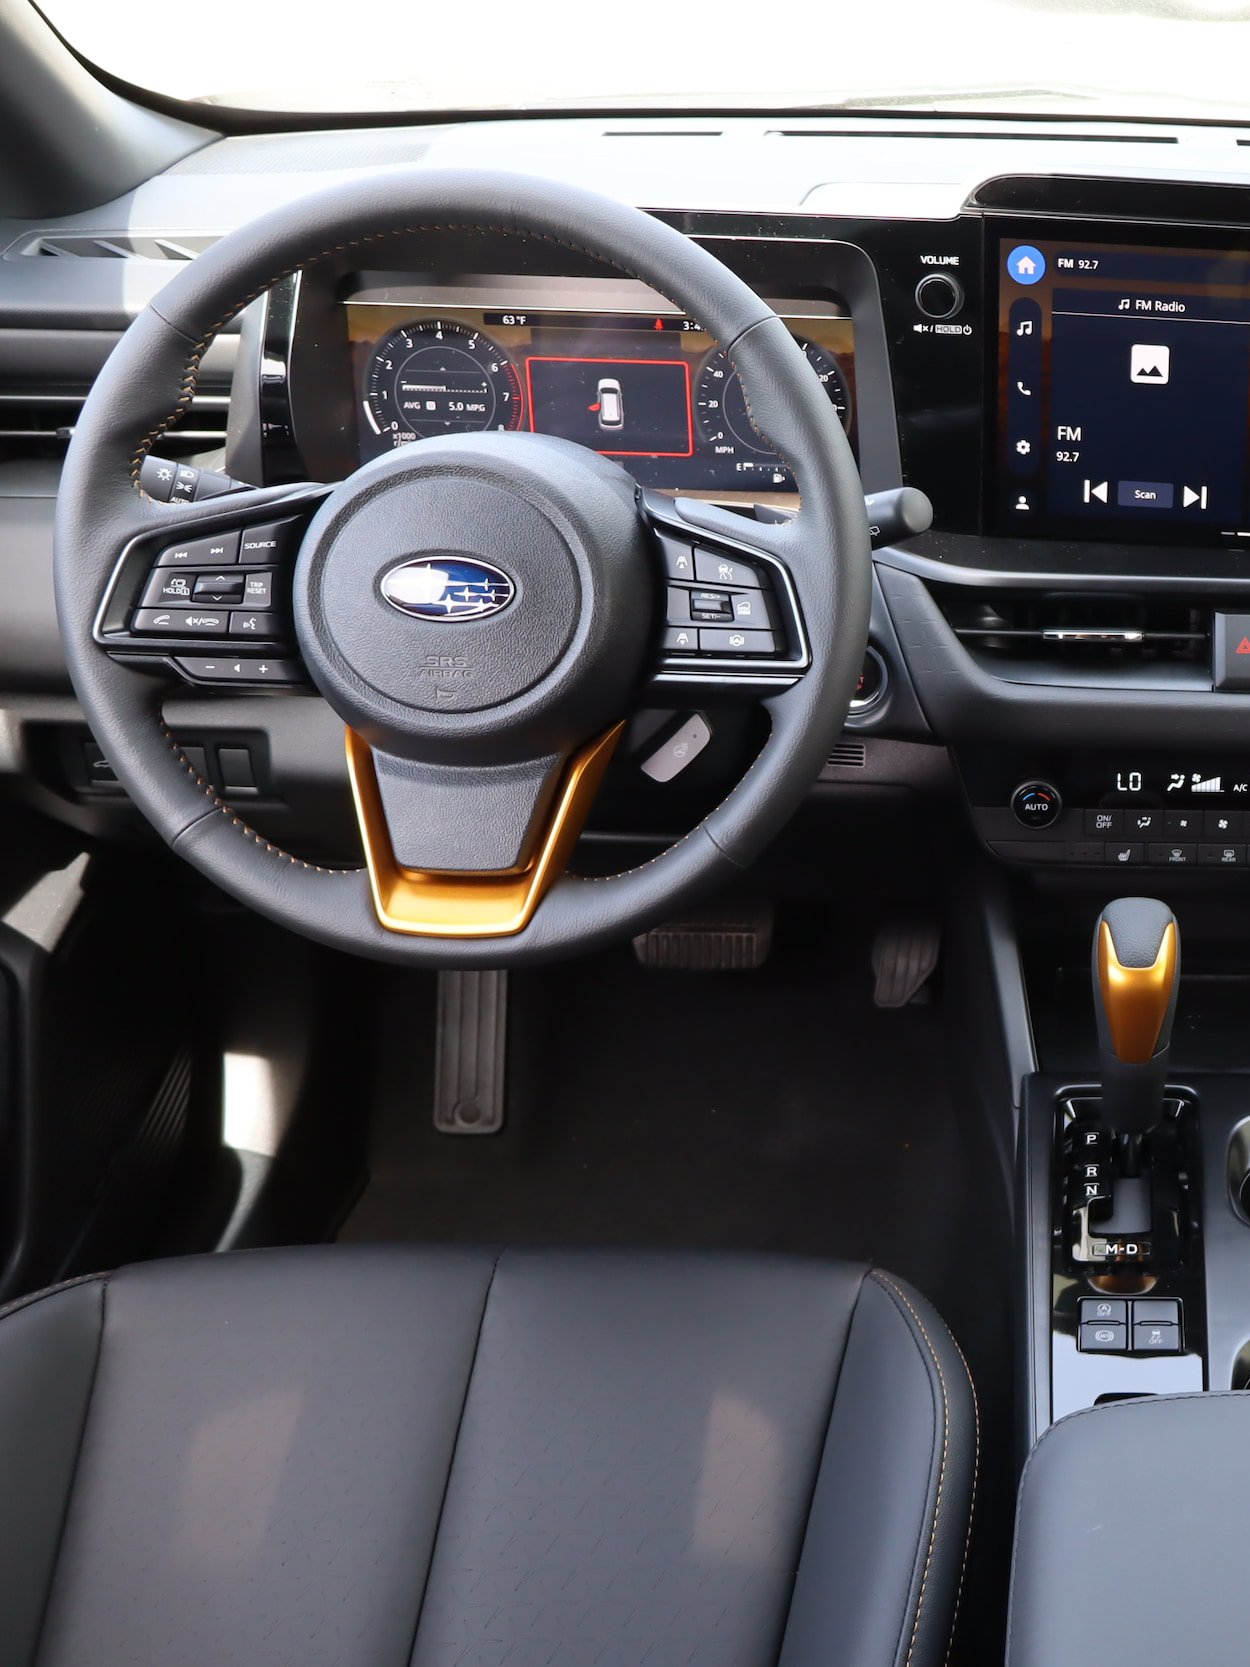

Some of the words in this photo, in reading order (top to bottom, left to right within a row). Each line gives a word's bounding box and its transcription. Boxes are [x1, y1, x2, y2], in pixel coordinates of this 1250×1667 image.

[920, 255, 960, 266] VOLUME
[1057, 258, 1074, 268] FM
[1078, 259, 1099, 270] 92.7
[1135, 300, 1151, 311] FM
[1155, 301, 1186, 313] Radio
[683, 321, 702, 330] 3:4
[937, 325, 961, 333] HOLD
[435, 331, 443, 340] 4
[406, 339, 414, 348] 3
[468, 339, 476, 349] 5
[385, 360, 393, 370] 2
[491, 363, 499, 372] 6
[713, 370, 724, 378] 40
[382, 390, 388, 399] 1
[502, 392, 510, 401] 7
[403, 401, 421, 410] AVG
[448, 402, 464, 411] 5.0
[466, 403, 486, 412] MPG
[708, 400, 719, 408] 20
[390, 421, 399, 430] 0
[392, 432, 416, 440] x1000
[717, 432, 724, 440] 0
[1057, 425, 1082, 441] FM
[714, 446, 735, 454] MPH
[1056, 451, 1080, 462] 92.7
[736, 463, 742, 471] E
[1134, 489, 1157, 500] Scan
[244, 540, 277, 550] SOURCE
[246, 587, 268, 595] RESET
[425, 655, 468, 667] SRS
[418, 668, 475, 678] AIRBAG
[1117, 772, 1142, 791] LO
[1233, 784, 1248, 792] A/C
[1024, 803, 1049, 811] AUTO
[1096, 815, 1112, 823] ON/
[1086, 1134, 1097, 1143] P
[1086, 1166, 1098, 1176] R
[1086, 1185, 1098, 1195] N
